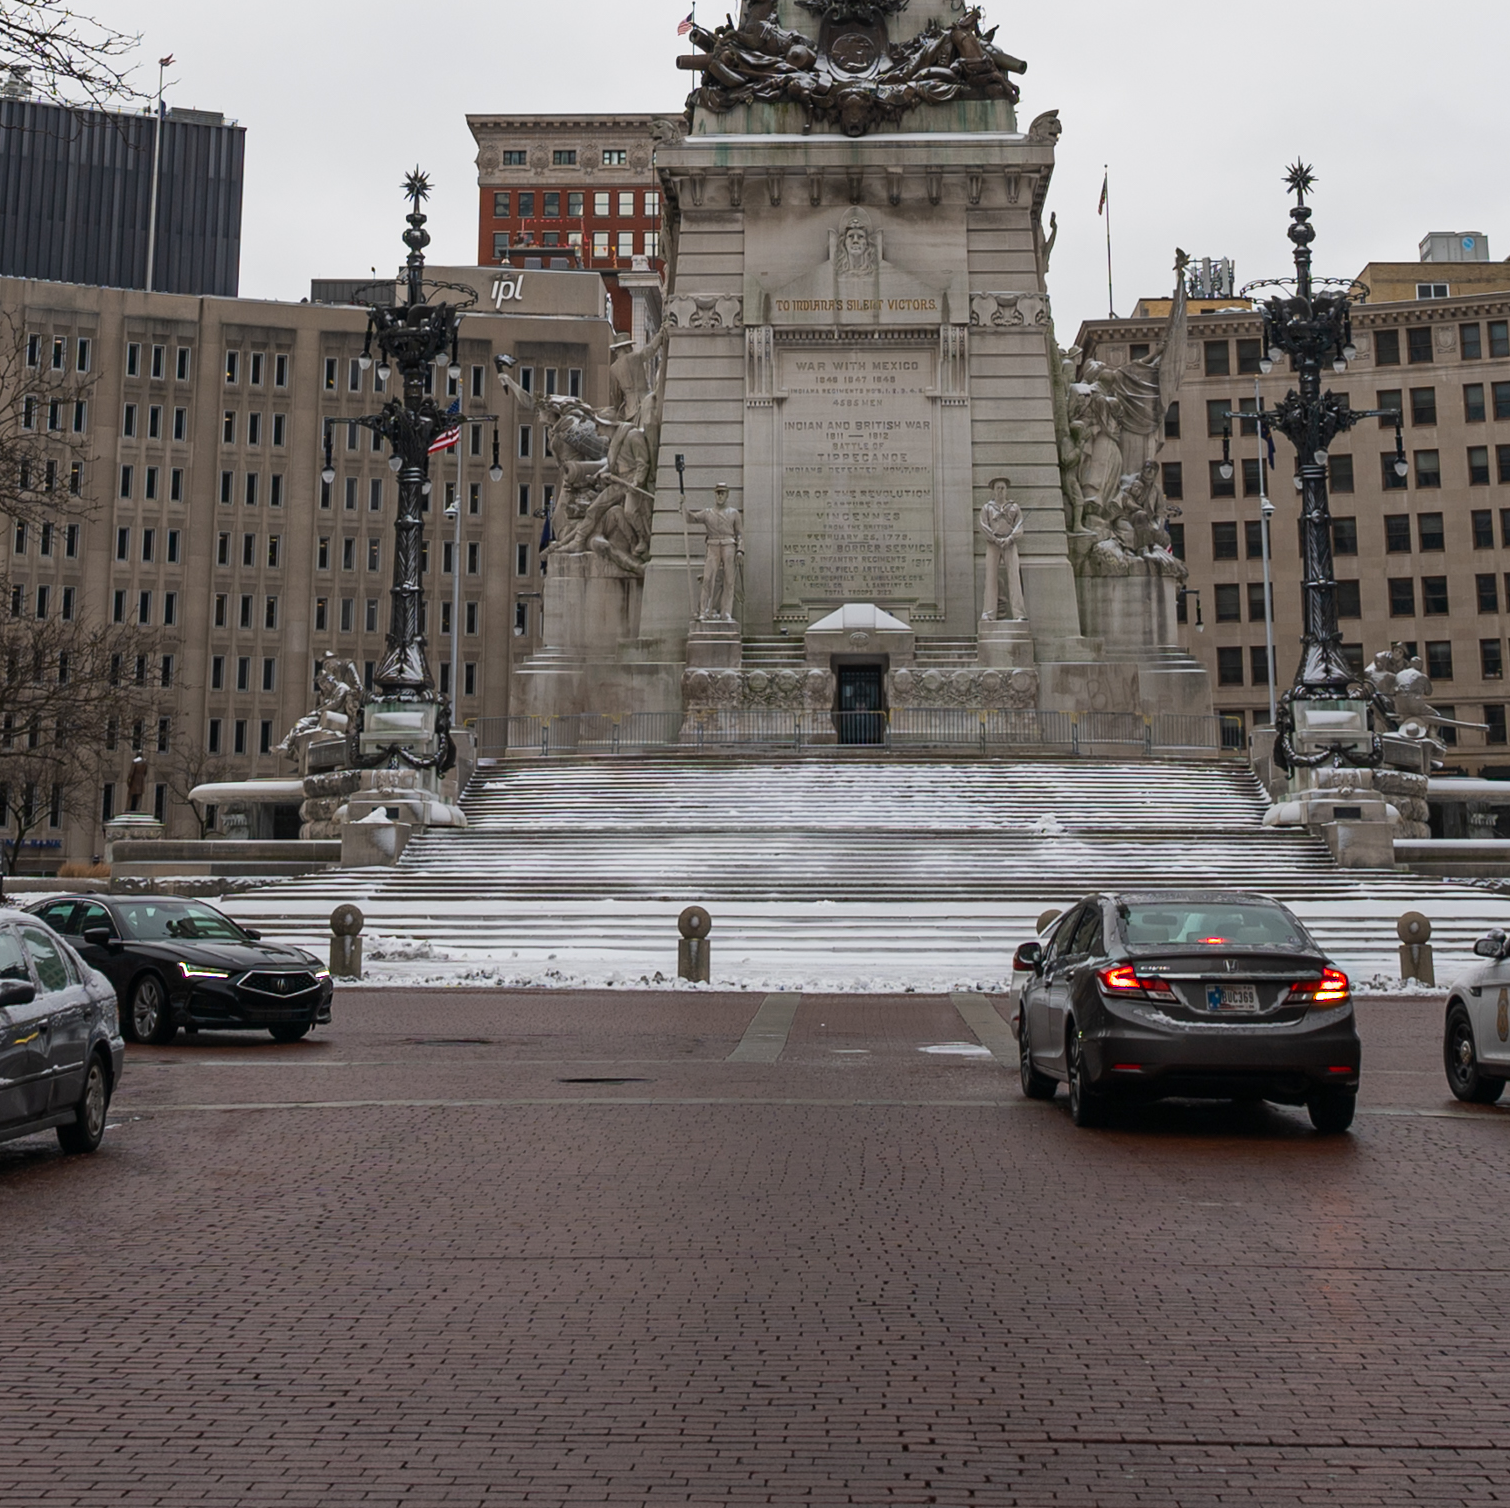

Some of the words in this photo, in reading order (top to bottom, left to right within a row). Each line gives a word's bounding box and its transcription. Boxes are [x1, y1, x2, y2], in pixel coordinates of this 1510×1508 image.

[776, 299, 790, 311] TO
[793, 299, 843, 311] INDIANA'S
[847, 299, 884, 311] SILENT
[887, 298, 938, 311] VICTORS.
[796, 361, 826, 371] WAR
[833, 361, 866, 371] WITH
[872, 361, 919, 370] MEXICO
[784, 421, 823, 431] INDIAN
[827, 421, 850, 430] AND
[855, 421, 901, 430] BRITISH
[905, 421, 930, 430] WAR
[873, 442, 884, 450] OF
[817, 453, 908, 462] TIPPECANOE
[785, 490, 810, 499] WAR
[814, 490, 829, 498] OF
[835, 490, 856, 498] THE
[860, 489, 931, 498] REVOLUTION
[817, 512, 901, 521] VINCENNES
[784, 544, 832, 553] MEXICAN
[837, 544, 881, 553] BORDER
[886, 544, 933, 553] SERVICE
[862, 565, 905, 573] ARTILLERY
